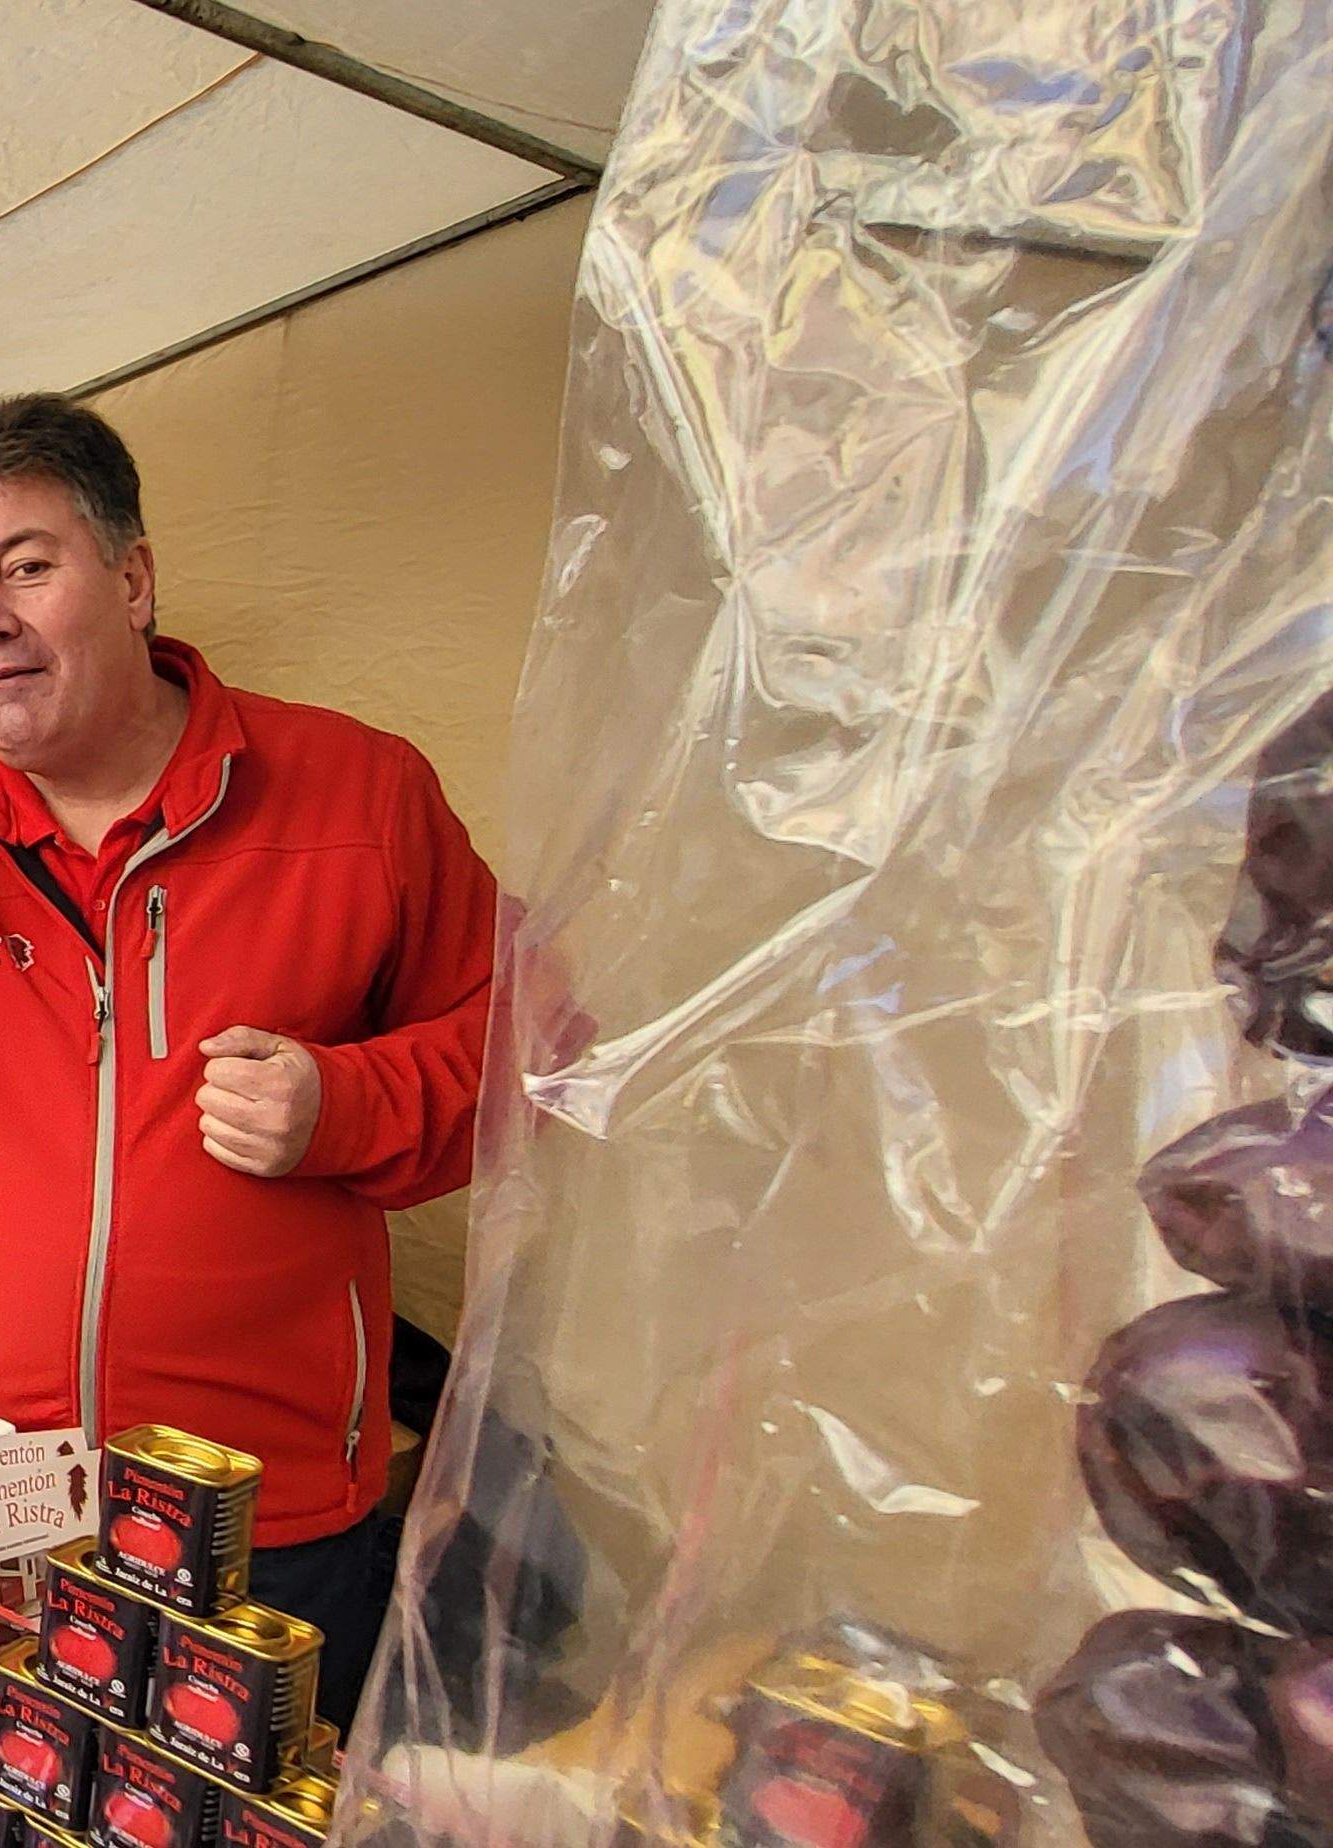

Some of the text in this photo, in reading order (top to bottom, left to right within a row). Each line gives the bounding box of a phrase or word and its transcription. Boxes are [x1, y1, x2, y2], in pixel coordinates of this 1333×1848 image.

[5, 1498, 65, 1529] Ristra
[107, 1480, 194, 1529] La Ristra
[141, 1578, 153, 1590] de
[155, 1584, 168, 1597] La
[47, 1590, 126, 1641] La Ristra
[163, 1647, 251, 1701] La Ristra
[90, 1693, 101, 1707] La
[20, 1704, 70, 1746] Ristra
[211, 1757, 225, 1771] La
[102, 1752, 183, 1814] La Ristra
[35, 1795, 47, 1809] La
